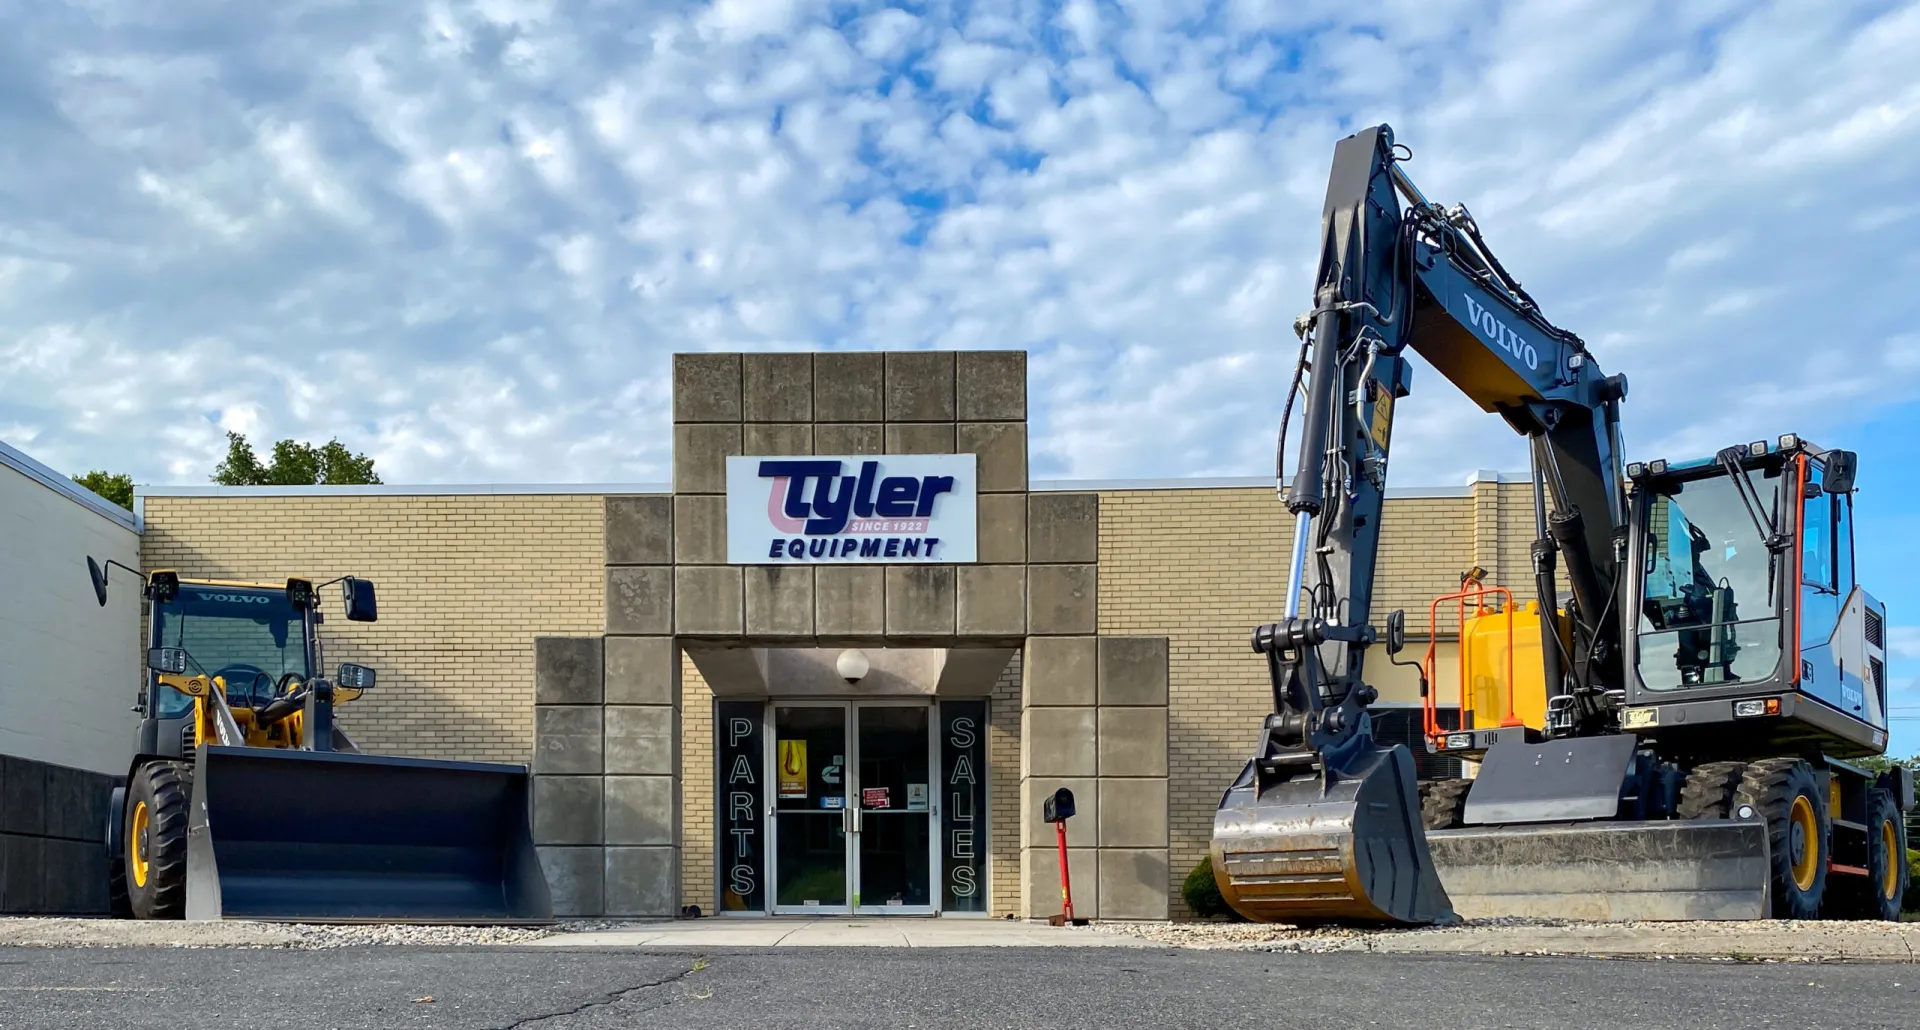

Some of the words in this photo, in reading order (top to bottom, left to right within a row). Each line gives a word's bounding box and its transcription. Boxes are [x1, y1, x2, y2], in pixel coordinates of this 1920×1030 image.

[1464, 293, 1538, 371] VOLVO
[758, 461, 954, 535] Tyler
[852, 521, 889, 532] SINCE
[893, 521, 922, 532] 1922
[769, 538, 939, 559] EQUIPMENT
[197, 593, 270, 604] VOLVO
[729, 718, 755, 896] PARTS
[950, 717, 976, 896] SALES
